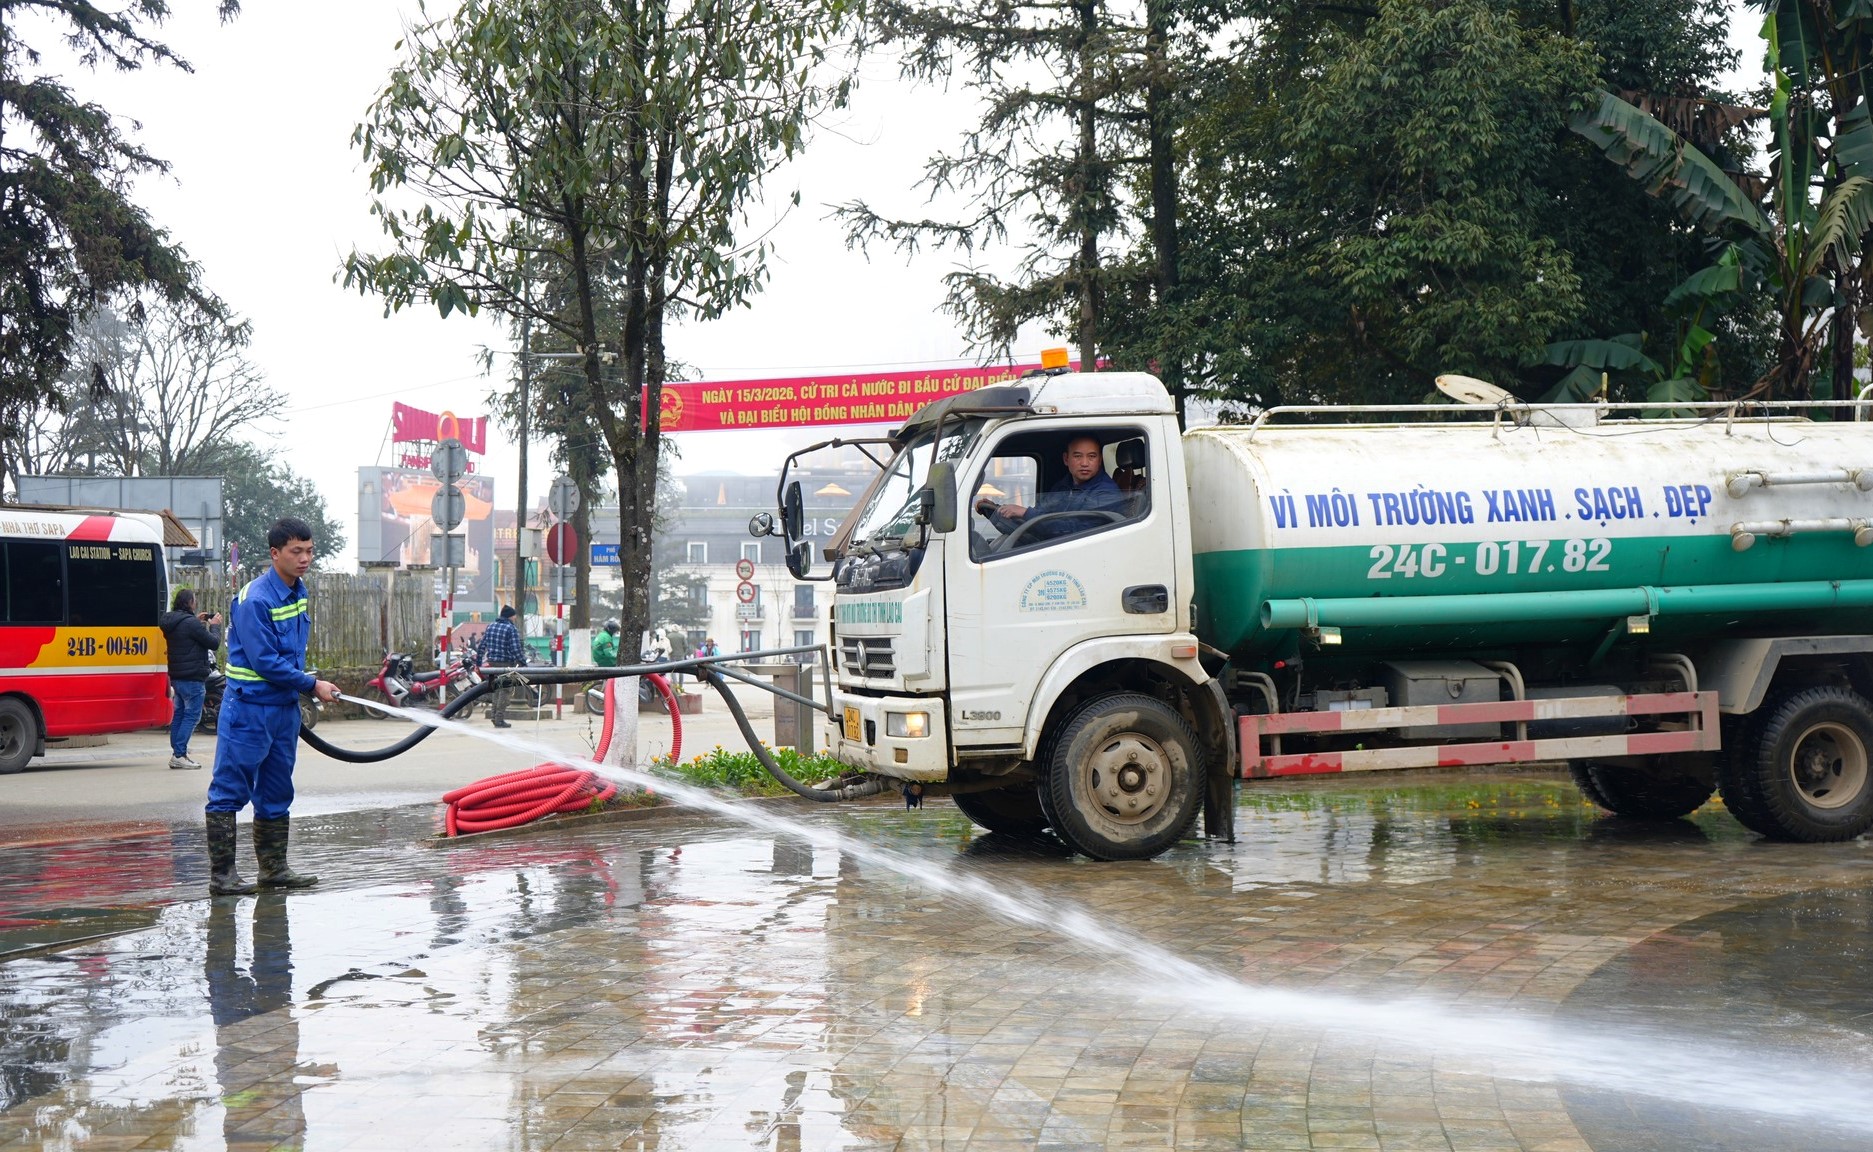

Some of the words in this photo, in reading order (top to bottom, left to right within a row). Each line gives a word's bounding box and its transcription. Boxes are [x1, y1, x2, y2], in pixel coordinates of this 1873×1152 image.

[702, 388, 733, 404] NGÀY
[736, 386, 797, 402] 15/3/2026,
[801, 381, 818, 399] CỬ
[820, 384, 838, 398] TRI
[842, 379, 858, 397] CẢ
[862, 376, 895, 396] NƯỚC
[898, 380, 910, 394] ĐI
[914, 374, 939, 393] BẦU
[943, 373, 961, 392] CỬ
[720, 408, 735, 424] VÀ
[738, 410, 758, 426] ĐẠI
[762, 404, 788, 422] BIỂU
[791, 406, 811, 424] HỘI
[814, 402, 847, 420] ĐỒNG
[851, 402, 884, 419] NHÂN
[888, 402, 914, 417] DÂN
[1269, 488, 1298, 528] VÌ
[1305, 487, 1359, 528] MÔI
[1367, 484, 1474, 526] TRƯỜNG
[1482, 488, 1556, 522] XANH
[1574, 486, 1644, 528] SẠCH
[1662, 485, 1712, 525] ĐẸP
[42, 523, 66, 536] SAPA
[69, 546, 80, 558] LAO
[90, 546, 110, 560] STATION
[119, 548, 132, 560] SAPA
[133, 548, 152, 561] CHURCH
[1367, 542, 1447, 579] 24C
[68, 637, 96, 656] 24B
[106, 636, 148, 656] 00450
